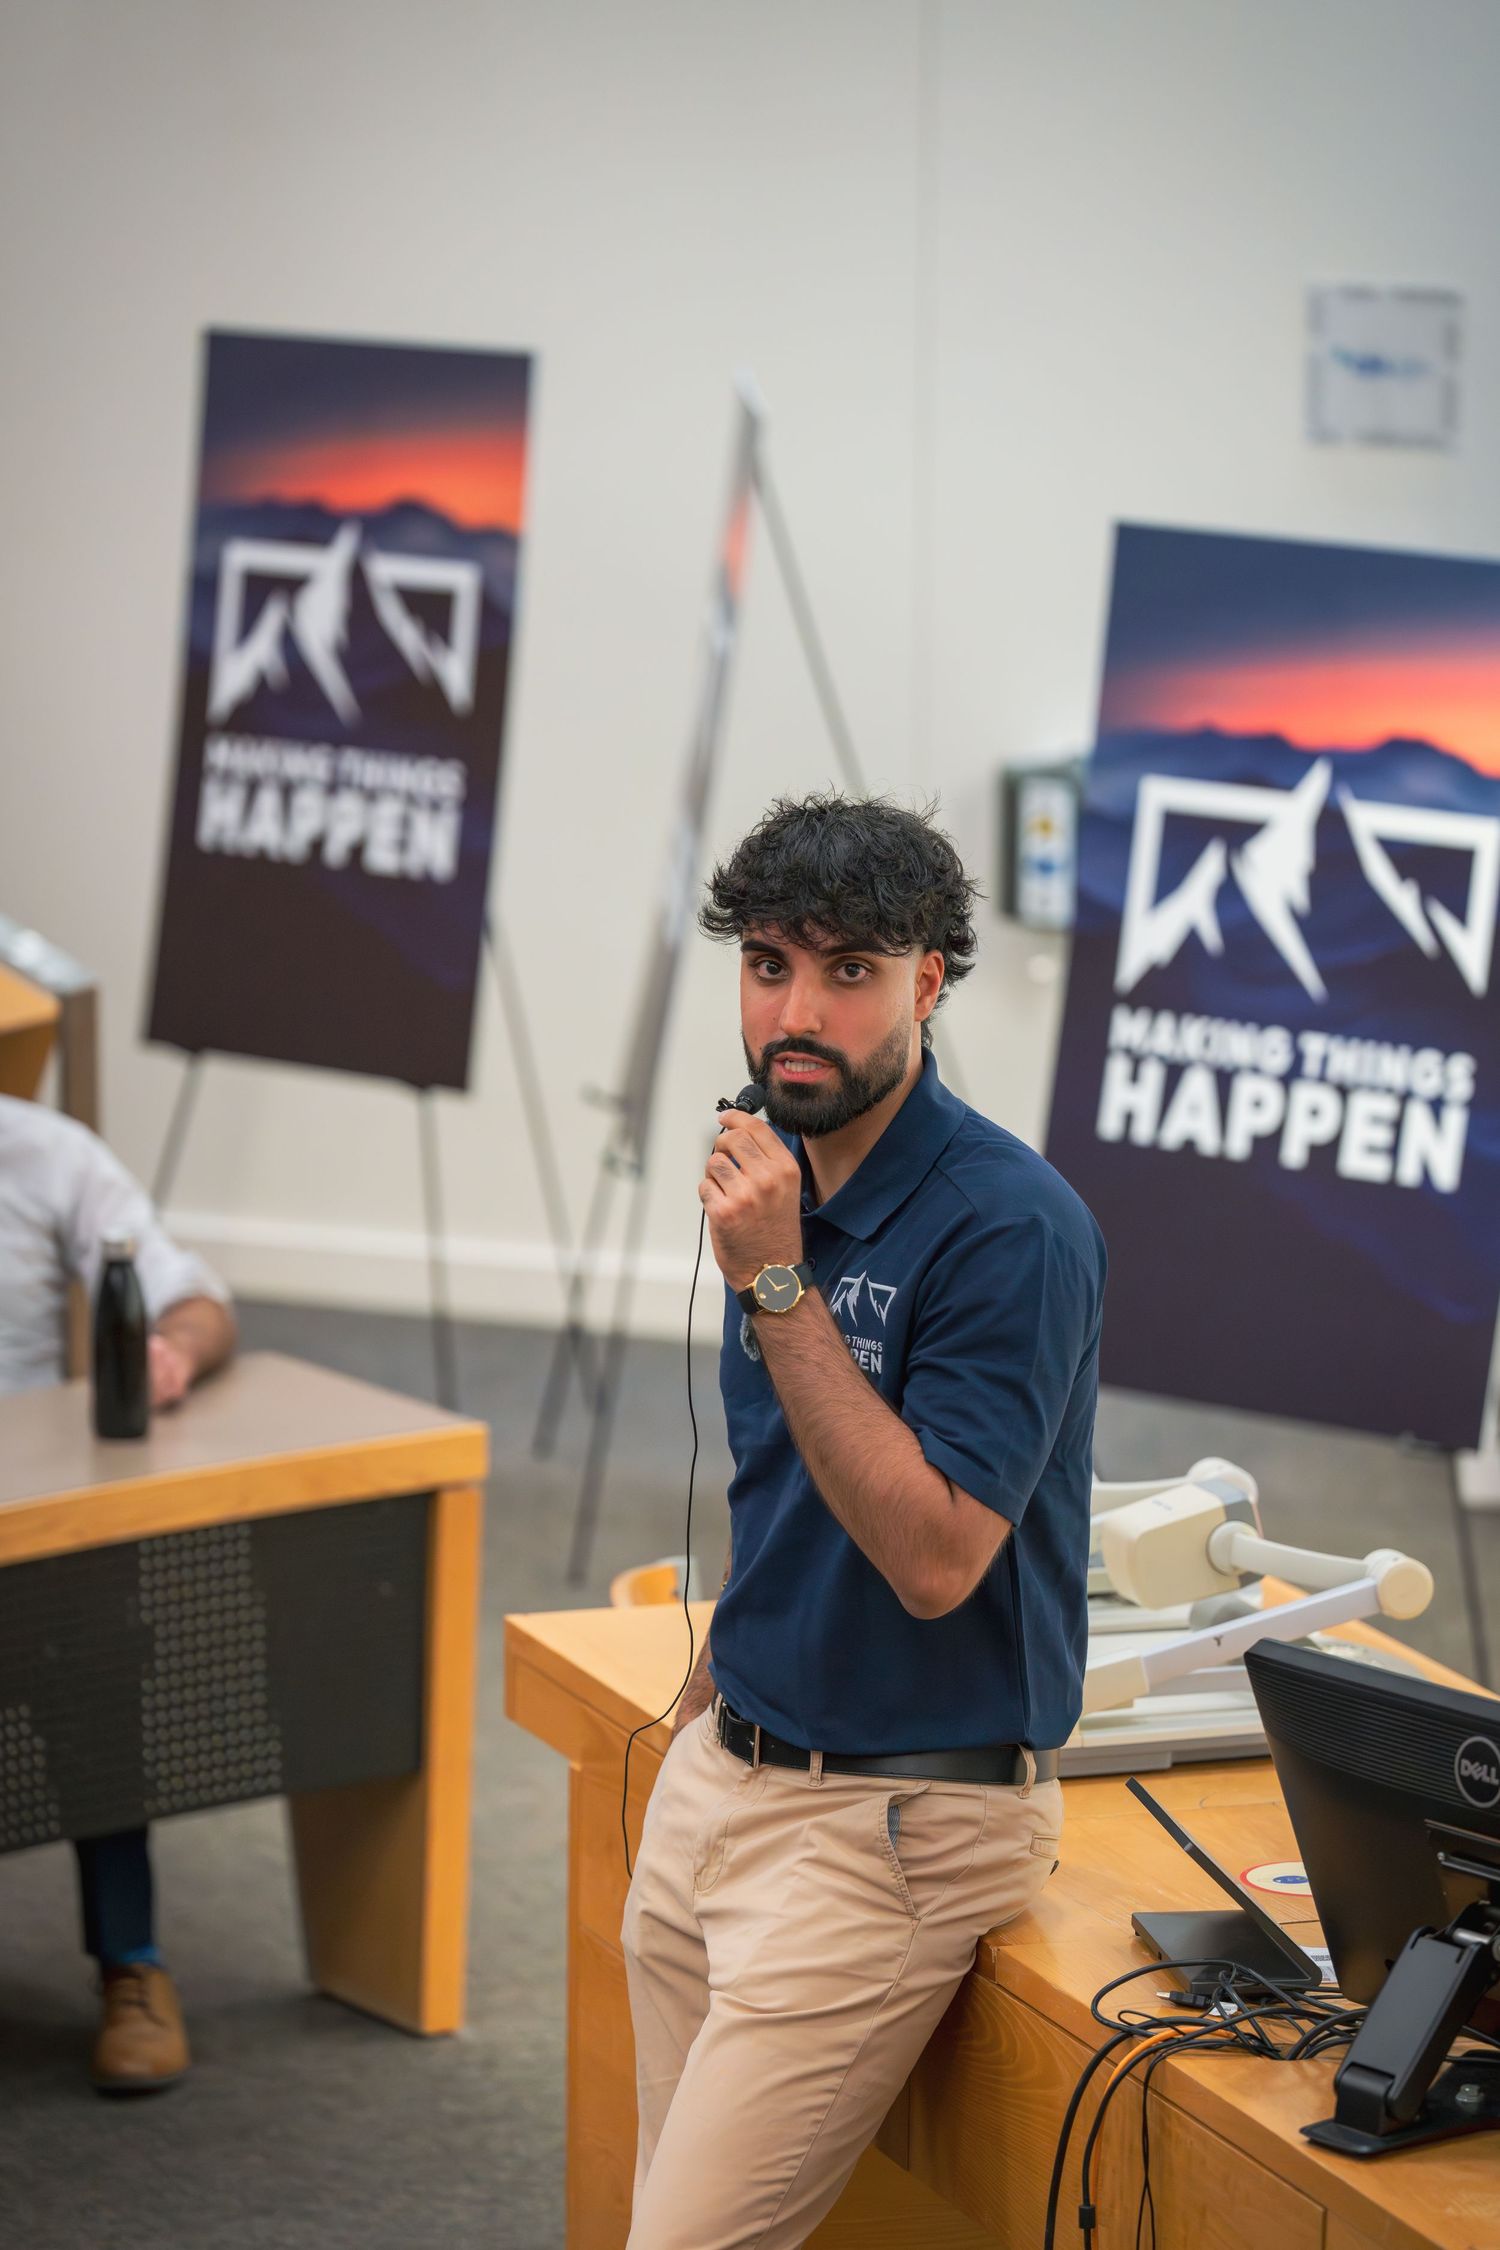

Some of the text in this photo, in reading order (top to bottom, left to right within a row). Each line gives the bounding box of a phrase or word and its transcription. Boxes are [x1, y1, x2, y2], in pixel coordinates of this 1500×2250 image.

[195, 774, 464, 884] HAPPEN
[1108, 1004, 1476, 1102] MAKING THINGS
[1097, 1051, 1470, 1194] HAPPEN
[850, 1348, 882, 1375] PEN
[852, 1335, 883, 1352] THINGS
[1460, 1758, 1500, 1786] DELL
